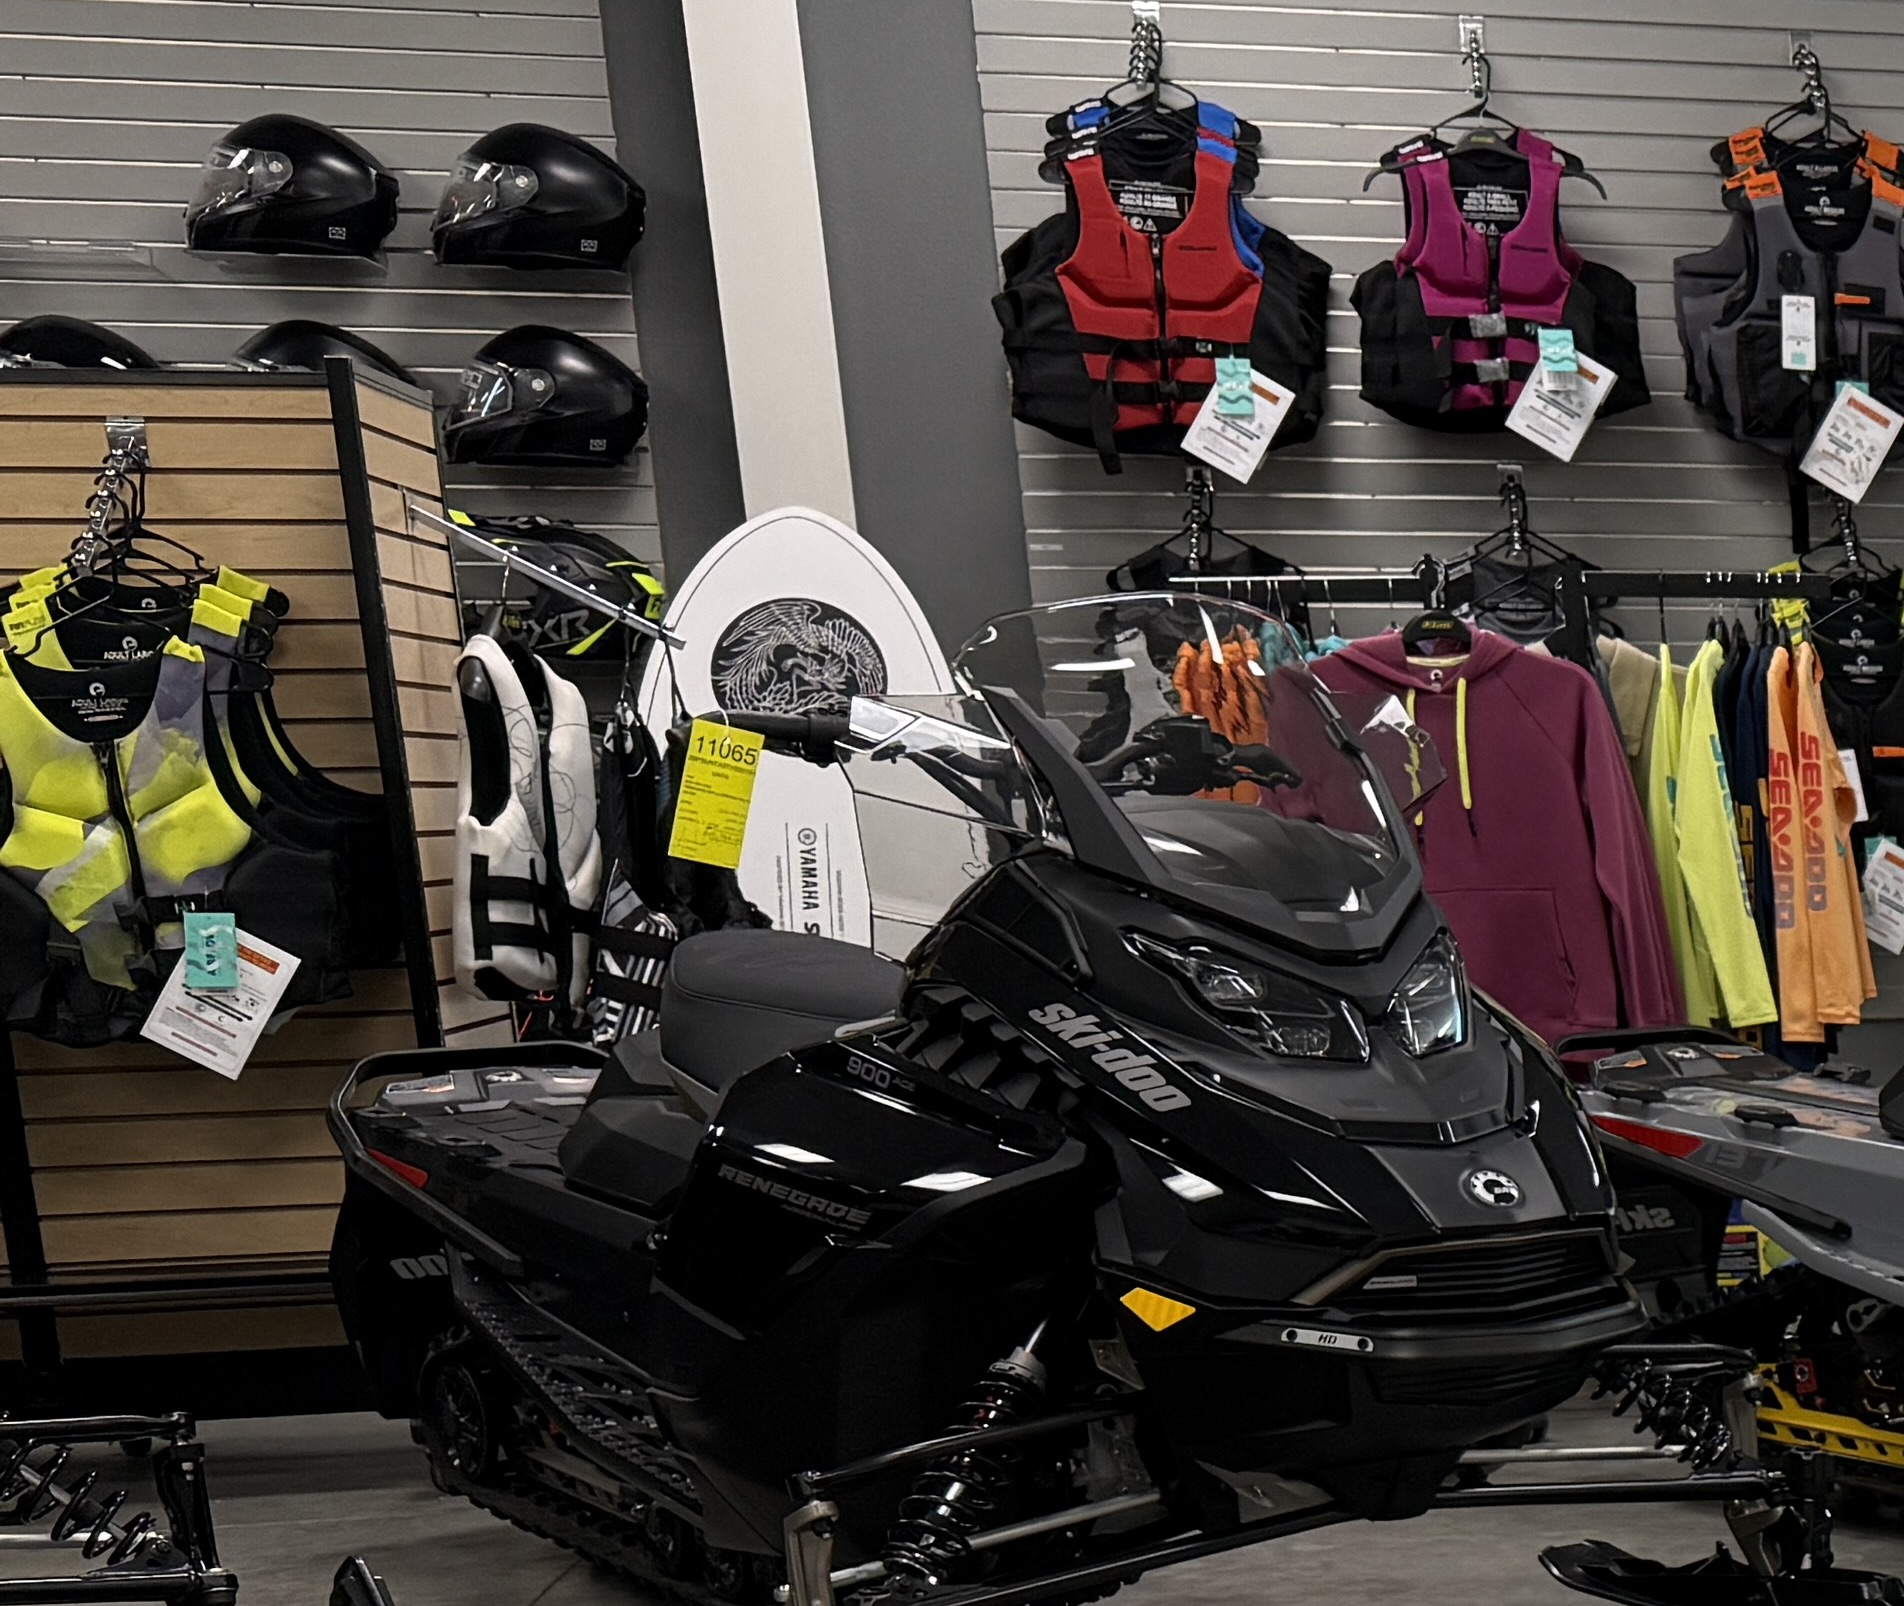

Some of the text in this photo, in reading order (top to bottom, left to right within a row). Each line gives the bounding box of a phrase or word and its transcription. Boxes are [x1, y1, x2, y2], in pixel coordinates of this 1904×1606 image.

[696, 736, 757, 766] 11065
[800, 847, 820, 910] YAMAHA
[846, 1055, 890, 1089] 900
[1028, 1003, 1192, 1112] ski-doo
[717, 1163, 873, 1225] RENEGADE
